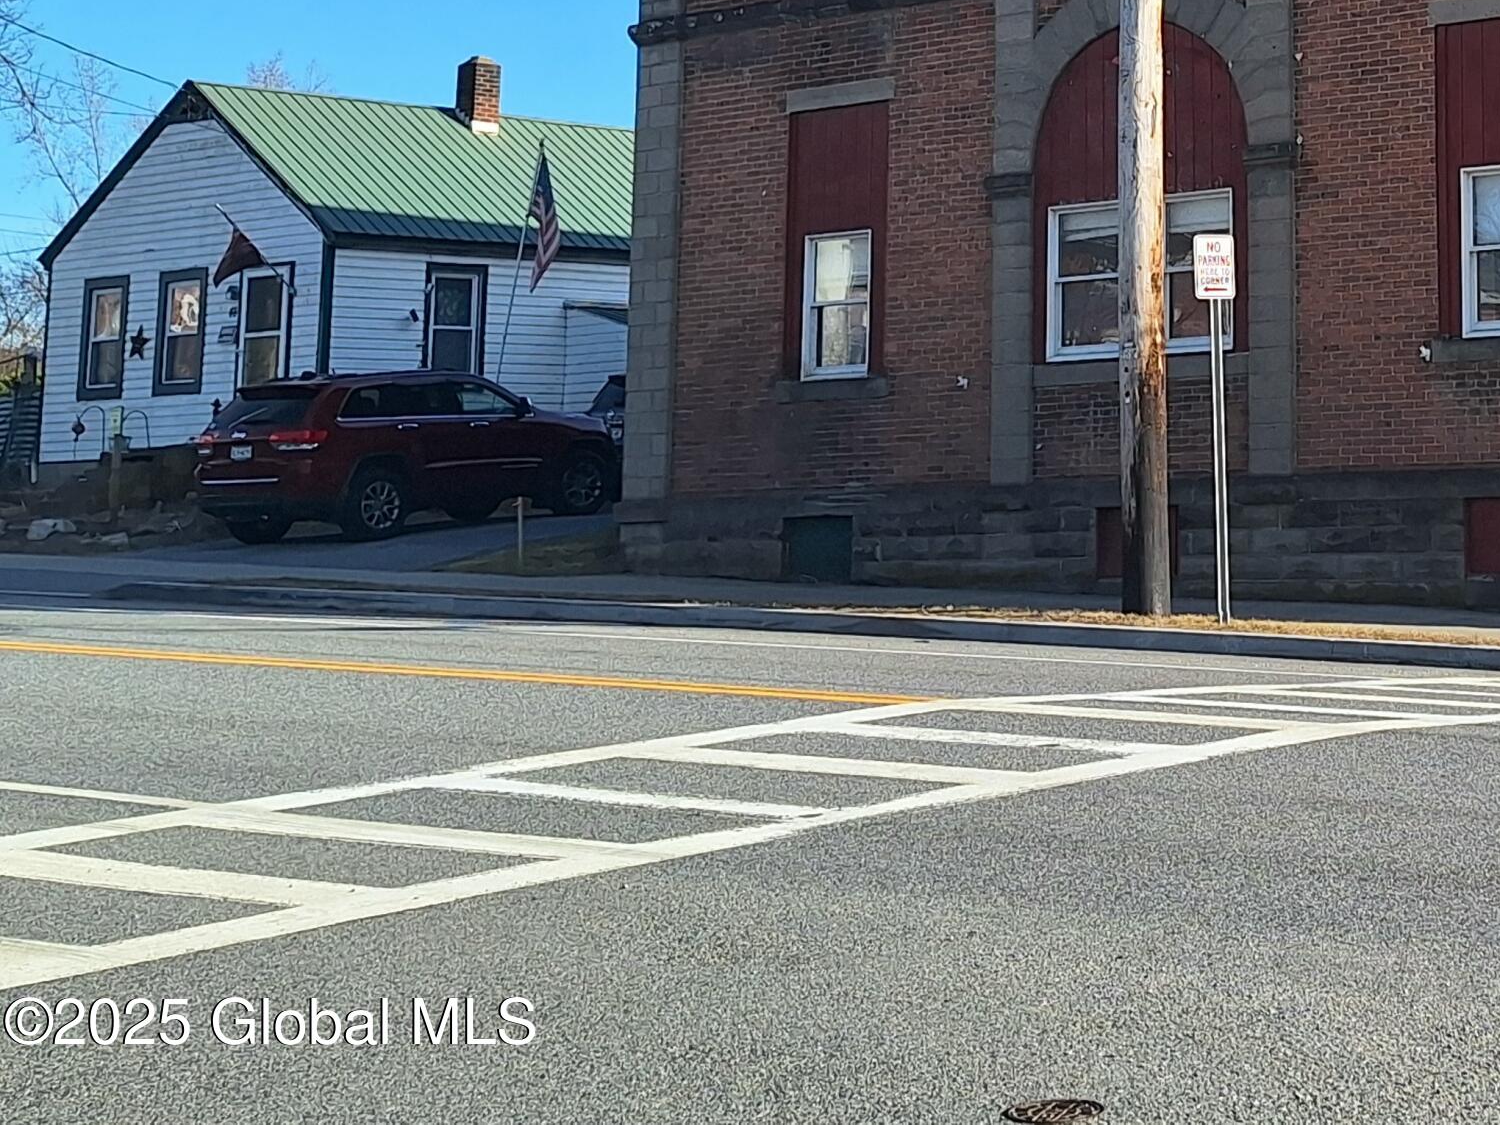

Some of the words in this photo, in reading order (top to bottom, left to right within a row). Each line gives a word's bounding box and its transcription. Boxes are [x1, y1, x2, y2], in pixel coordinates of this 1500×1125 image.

[1206, 241, 1221, 253] NO
[1198, 255, 1231, 267] PARKING
[1200, 277, 1230, 285] CORNER
